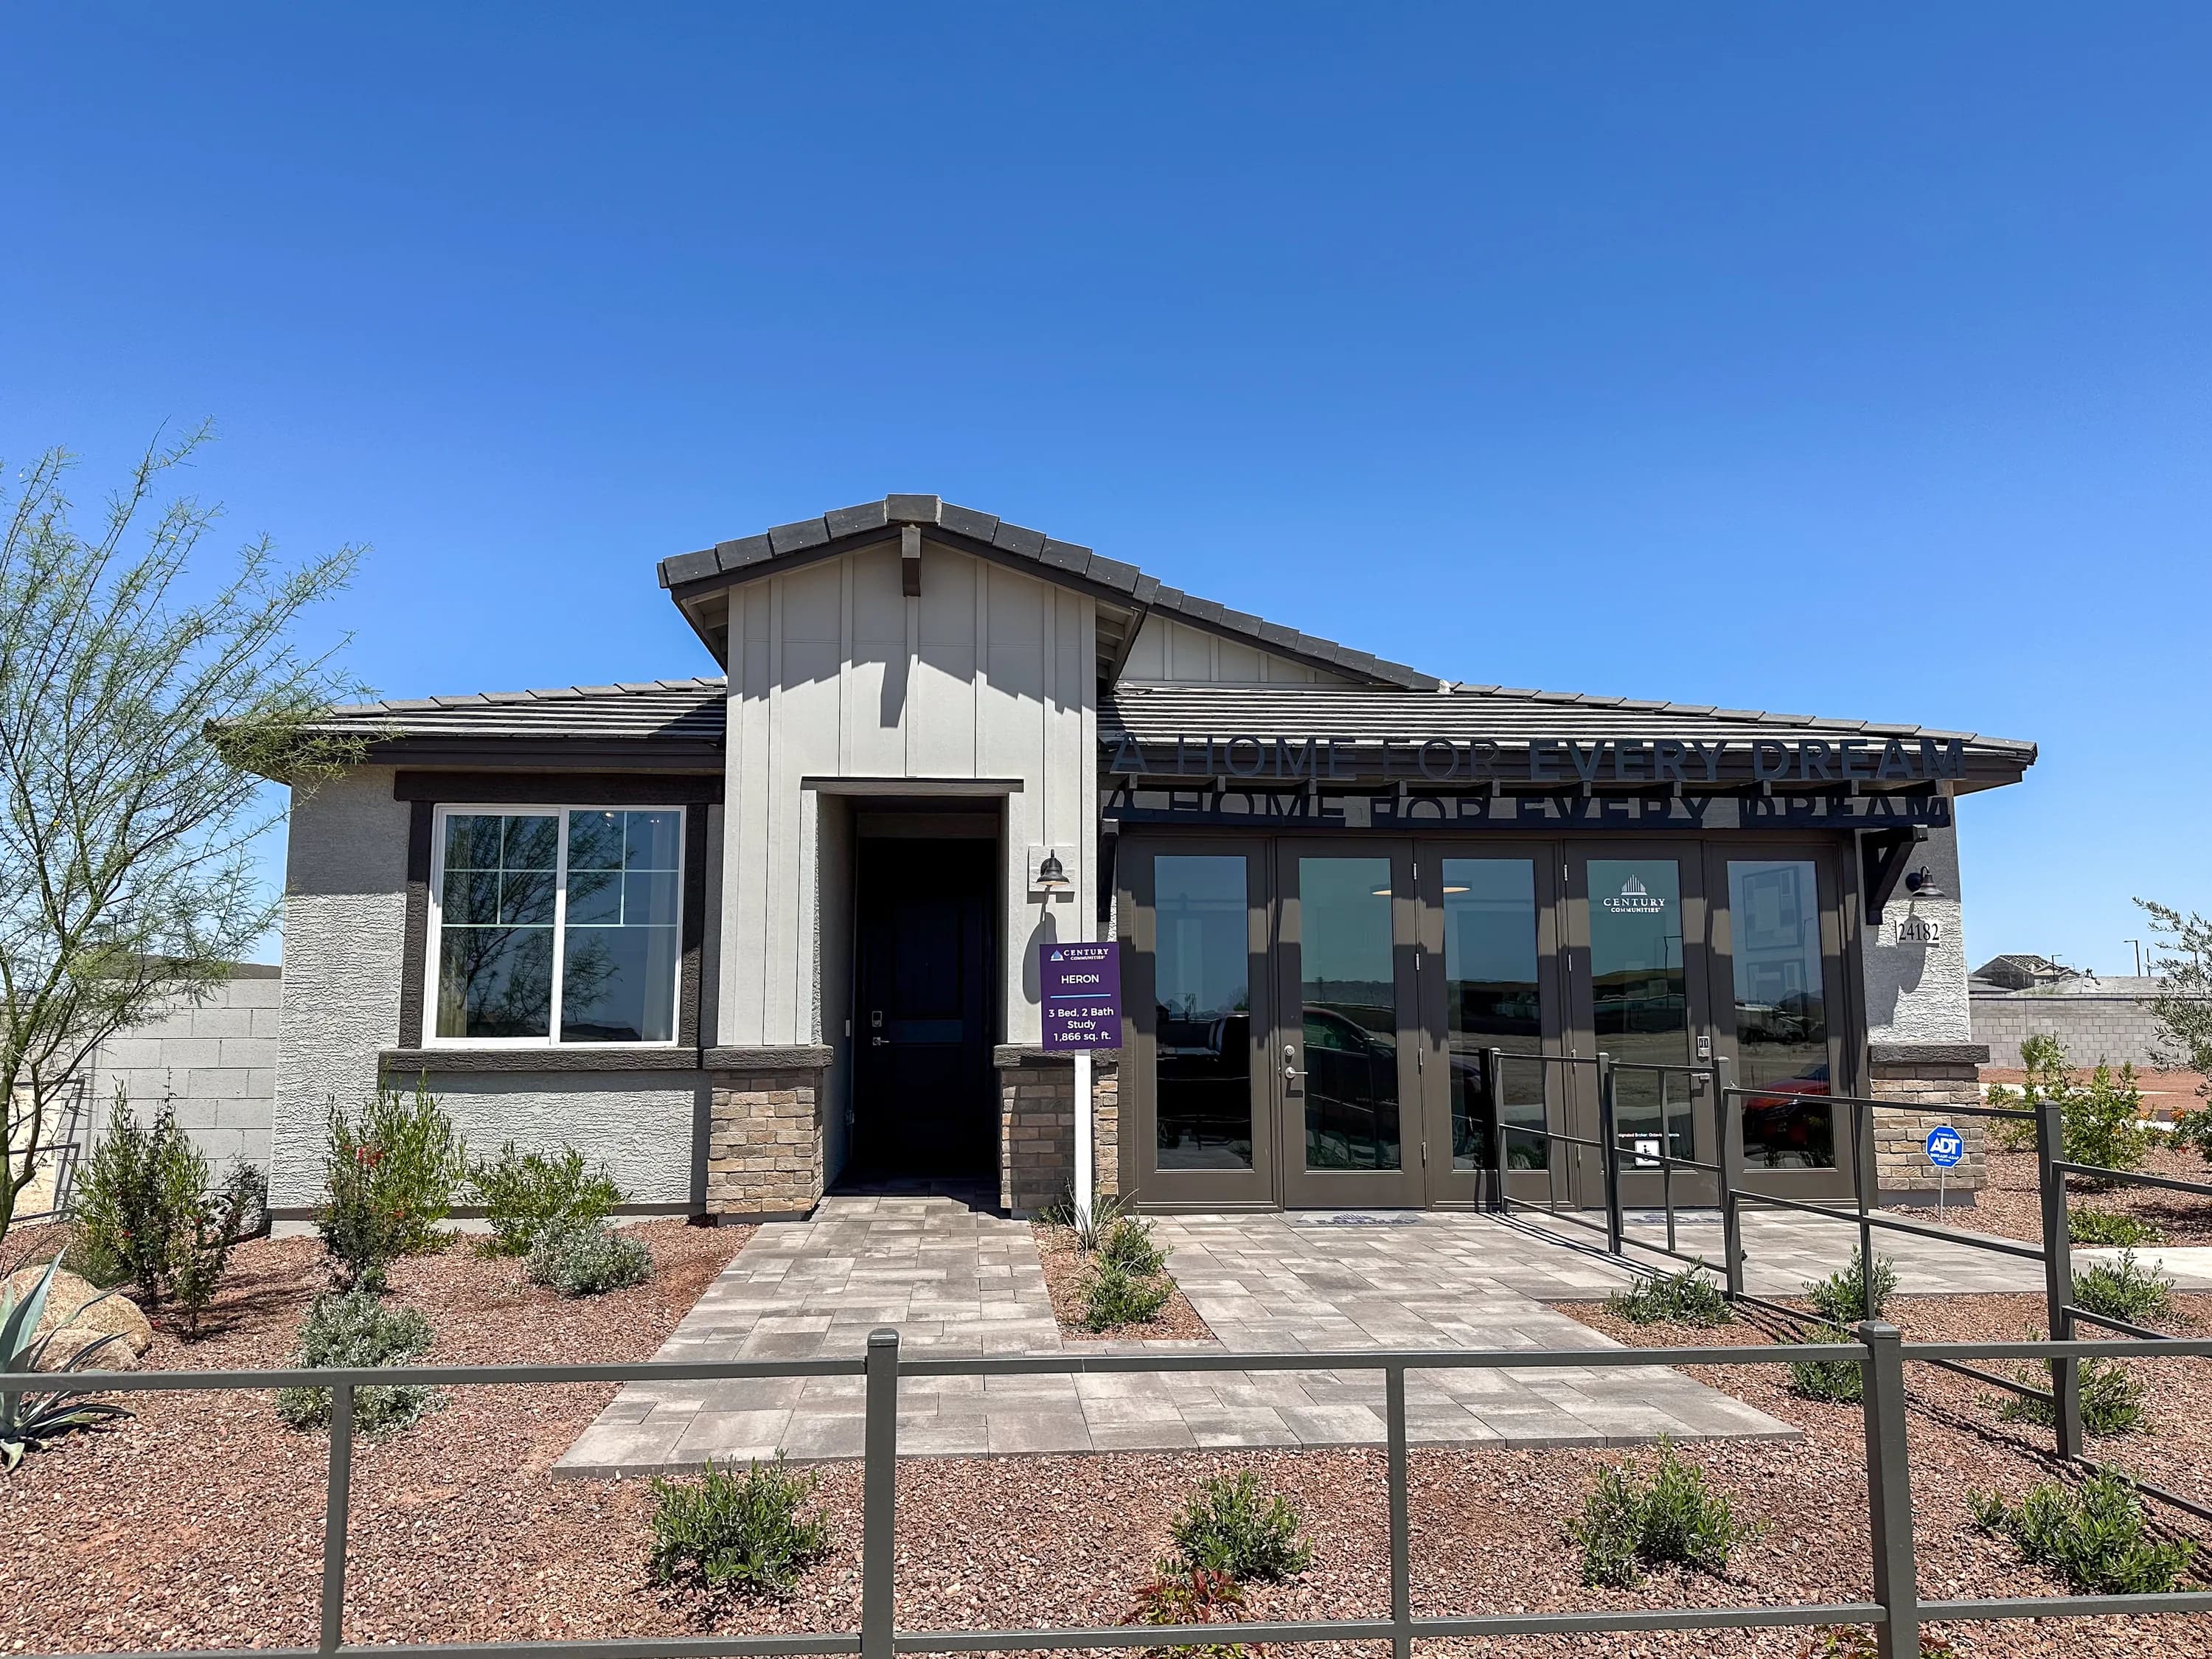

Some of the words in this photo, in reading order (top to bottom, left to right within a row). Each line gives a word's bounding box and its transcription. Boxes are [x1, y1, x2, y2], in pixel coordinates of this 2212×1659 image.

[1110, 732, 1149, 773] A
[1178, 734, 1357, 780] HOME
[1383, 737, 1500, 782] FOR
[1528, 738, 1728, 781] EVERY
[1753, 737, 1966, 779] DREAM
[1603, 898, 1666, 907] CENTURY
[1898, 923, 1940, 941] 24182
[1063, 948, 1109, 956] CENTURY
[1061, 974, 1099, 984] HERON
[1048, 1009, 1055, 1018] 3
[1057, 1008, 1079, 1018] Bed,
[1082, 1008, 1088, 1017] 2
[1091, 1007, 1114, 1017] Bath
[1067, 1020, 1096, 1030] Study
[1054, 1032, 1081, 1042] 1,866
[1083, 1034, 1098, 1042] sq.
[1101, 1031, 1111, 1040] ft.
[1930, 1136, 1961, 1155] ADT
